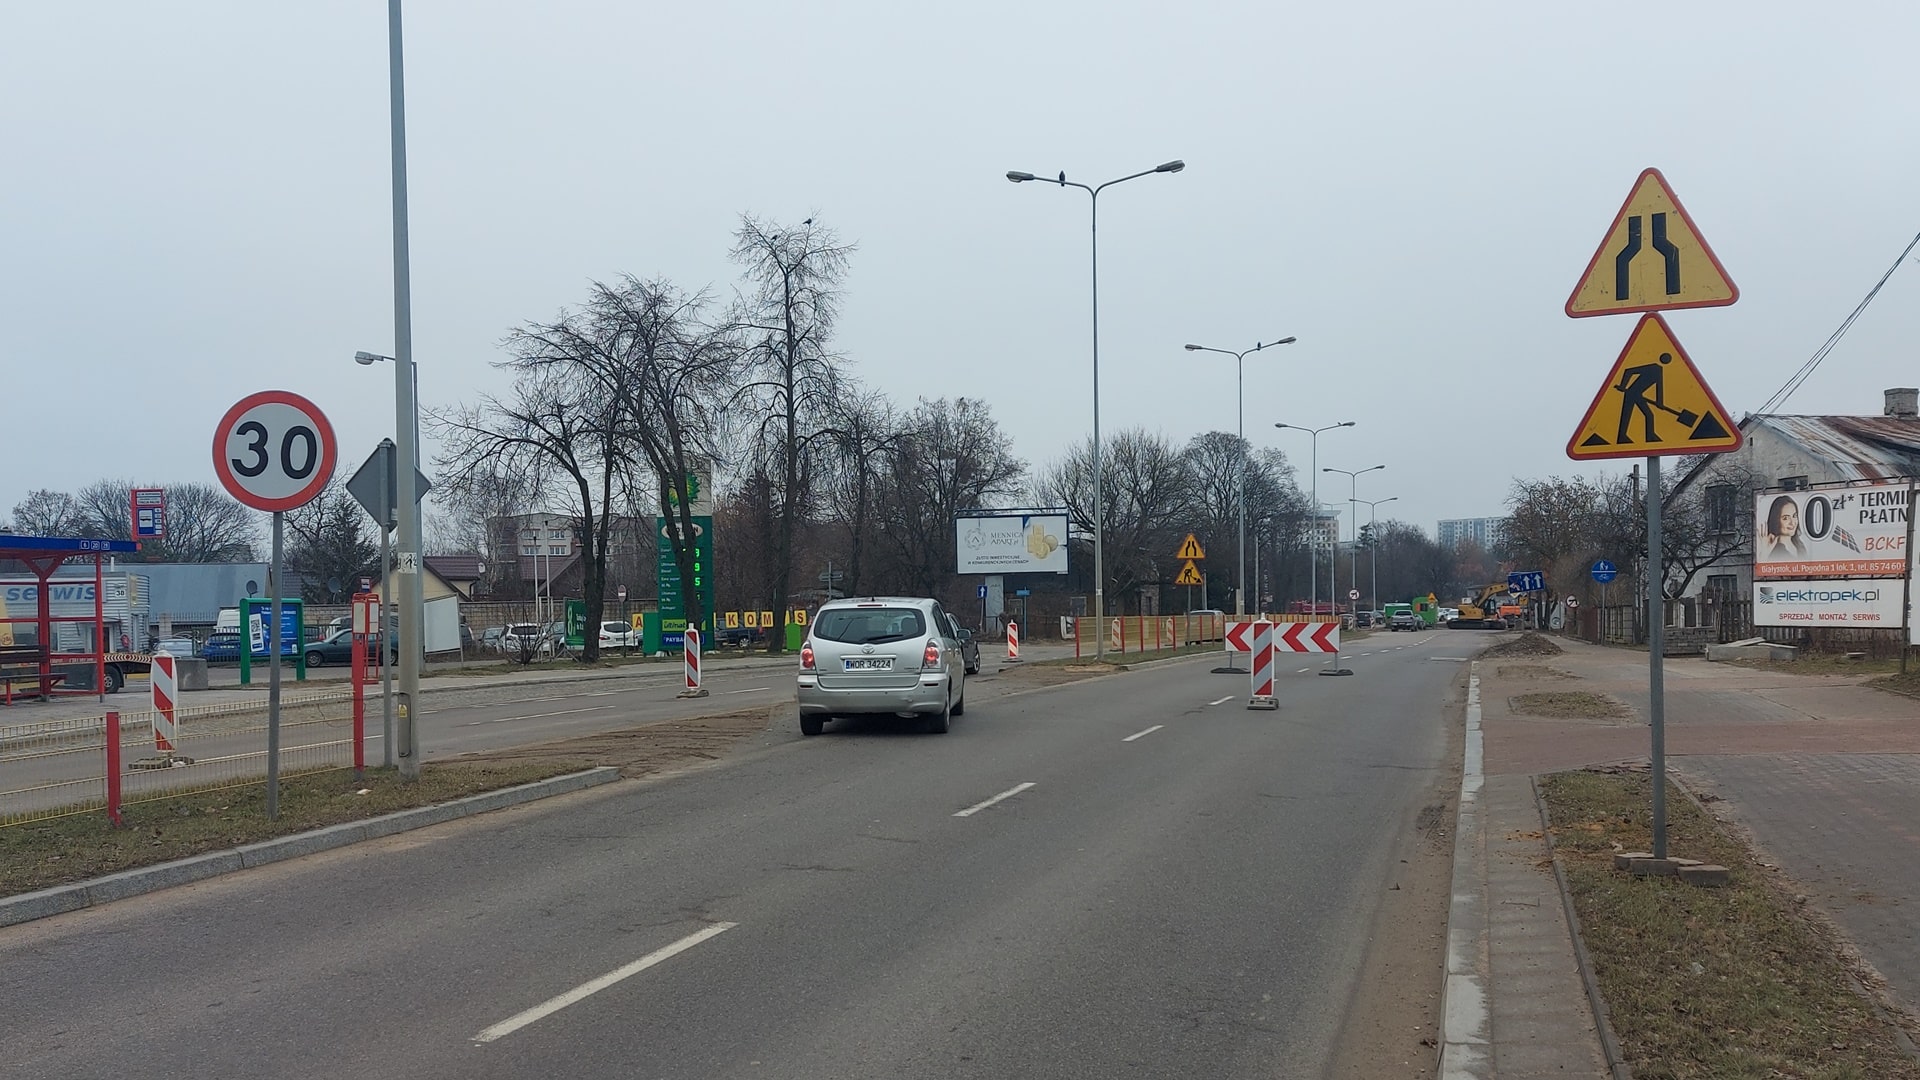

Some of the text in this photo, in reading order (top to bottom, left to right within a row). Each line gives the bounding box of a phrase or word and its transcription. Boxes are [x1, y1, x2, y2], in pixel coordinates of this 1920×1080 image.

[231, 421, 317, 479] 30
[1805, 496, 1831, 538] 0
[1865, 536, 1906, 550] BCKF
[1801, 563, 1830, 574] Pogodna
[1776, 589, 1880, 604] elektropek.pl
[1852, 613, 1881, 621] SERWIS
[850, 661, 890, 669] WOR 34224
